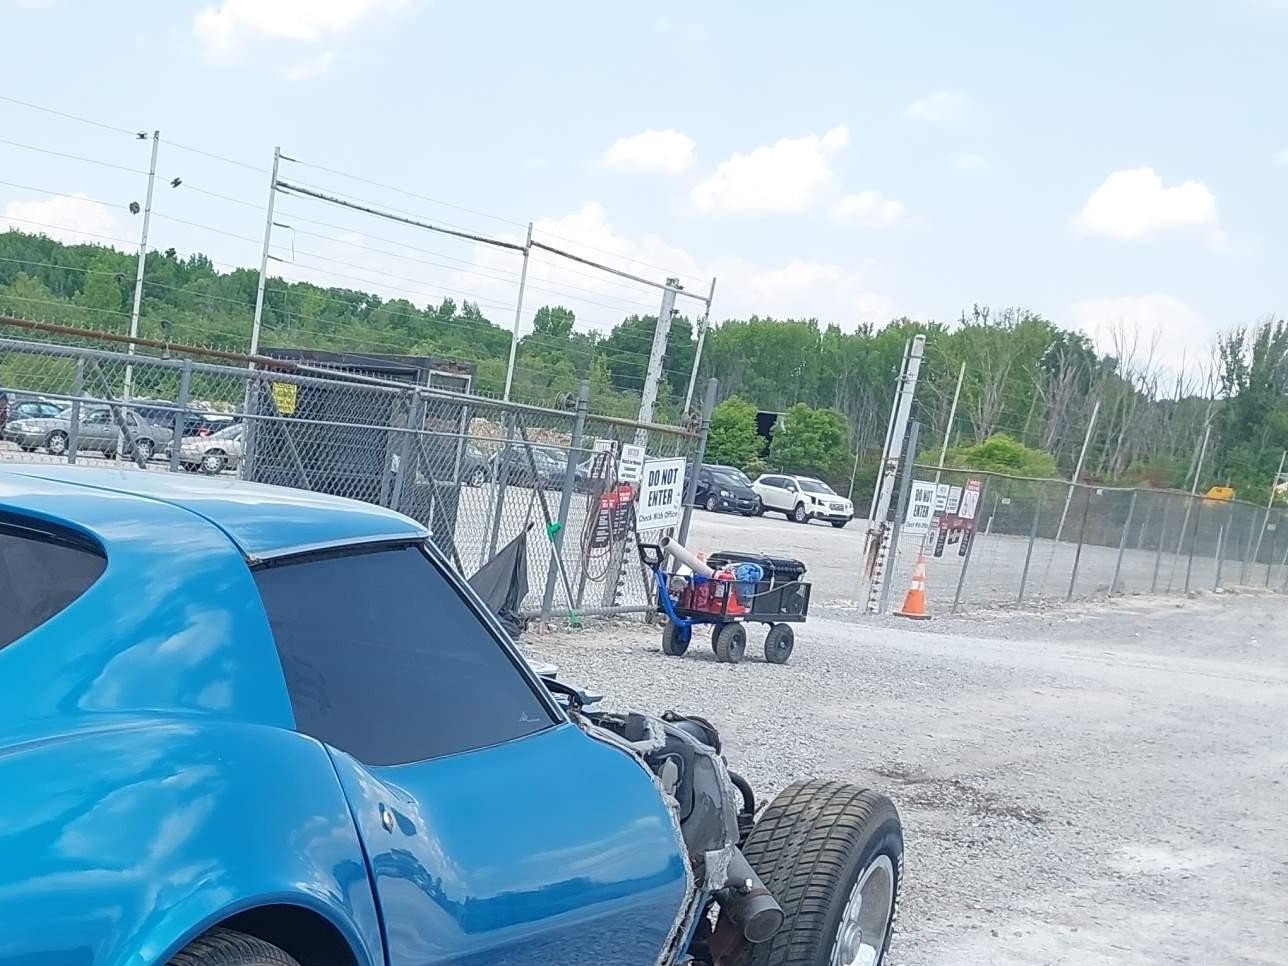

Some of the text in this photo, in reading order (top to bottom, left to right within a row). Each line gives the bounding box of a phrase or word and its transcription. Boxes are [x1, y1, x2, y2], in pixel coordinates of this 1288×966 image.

[648, 468, 679, 487] DO NOT
[648, 488, 673, 507] ENTER
[914, 488, 923, 502] DO
[923, 489, 933, 503] NOT
[639, 513, 652, 522] Check
[653, 512, 663, 520] With
[913, 504, 929, 518] ENTER
